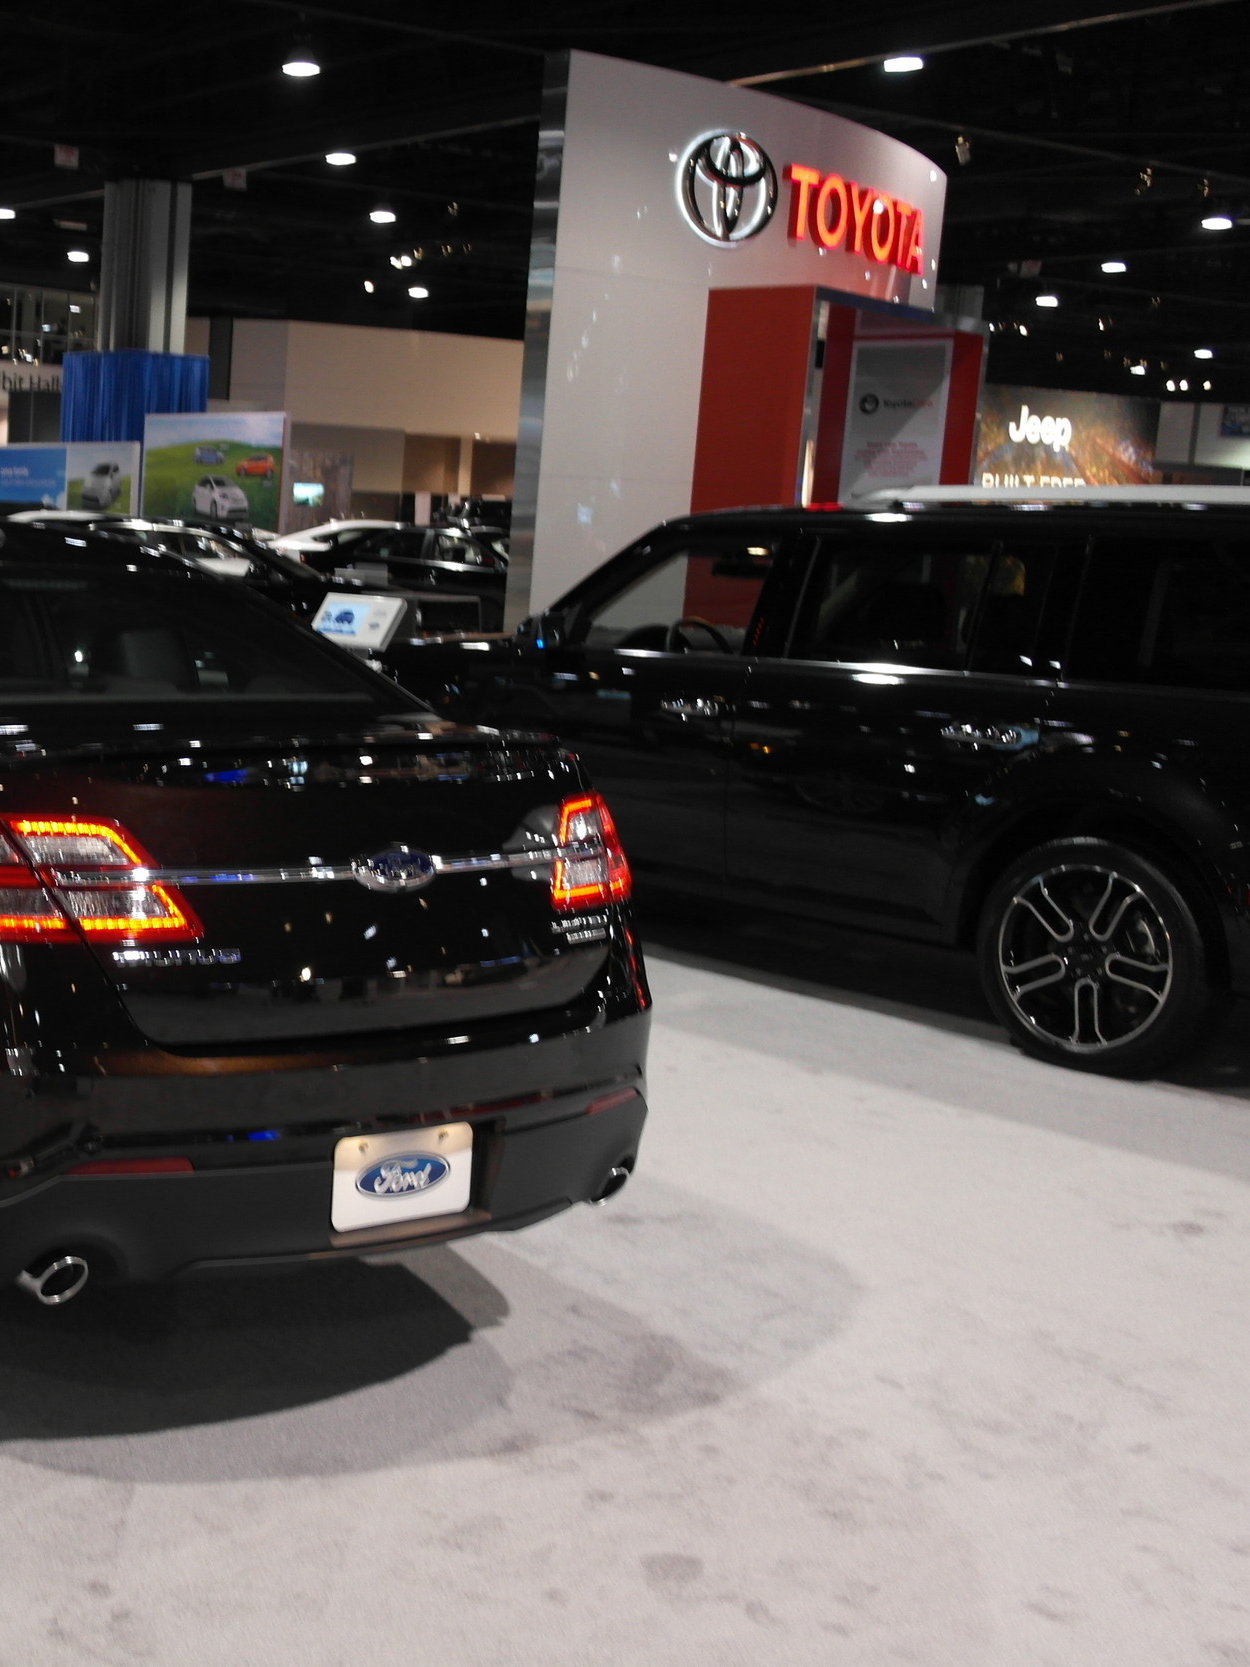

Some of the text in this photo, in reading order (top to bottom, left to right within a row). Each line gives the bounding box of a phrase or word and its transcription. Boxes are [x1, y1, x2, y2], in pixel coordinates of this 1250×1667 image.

[783, 162, 924, 276] TOYOTA
[1008, 404, 1073, 453] Jeep
[373, 1158, 433, 1195] Ford
